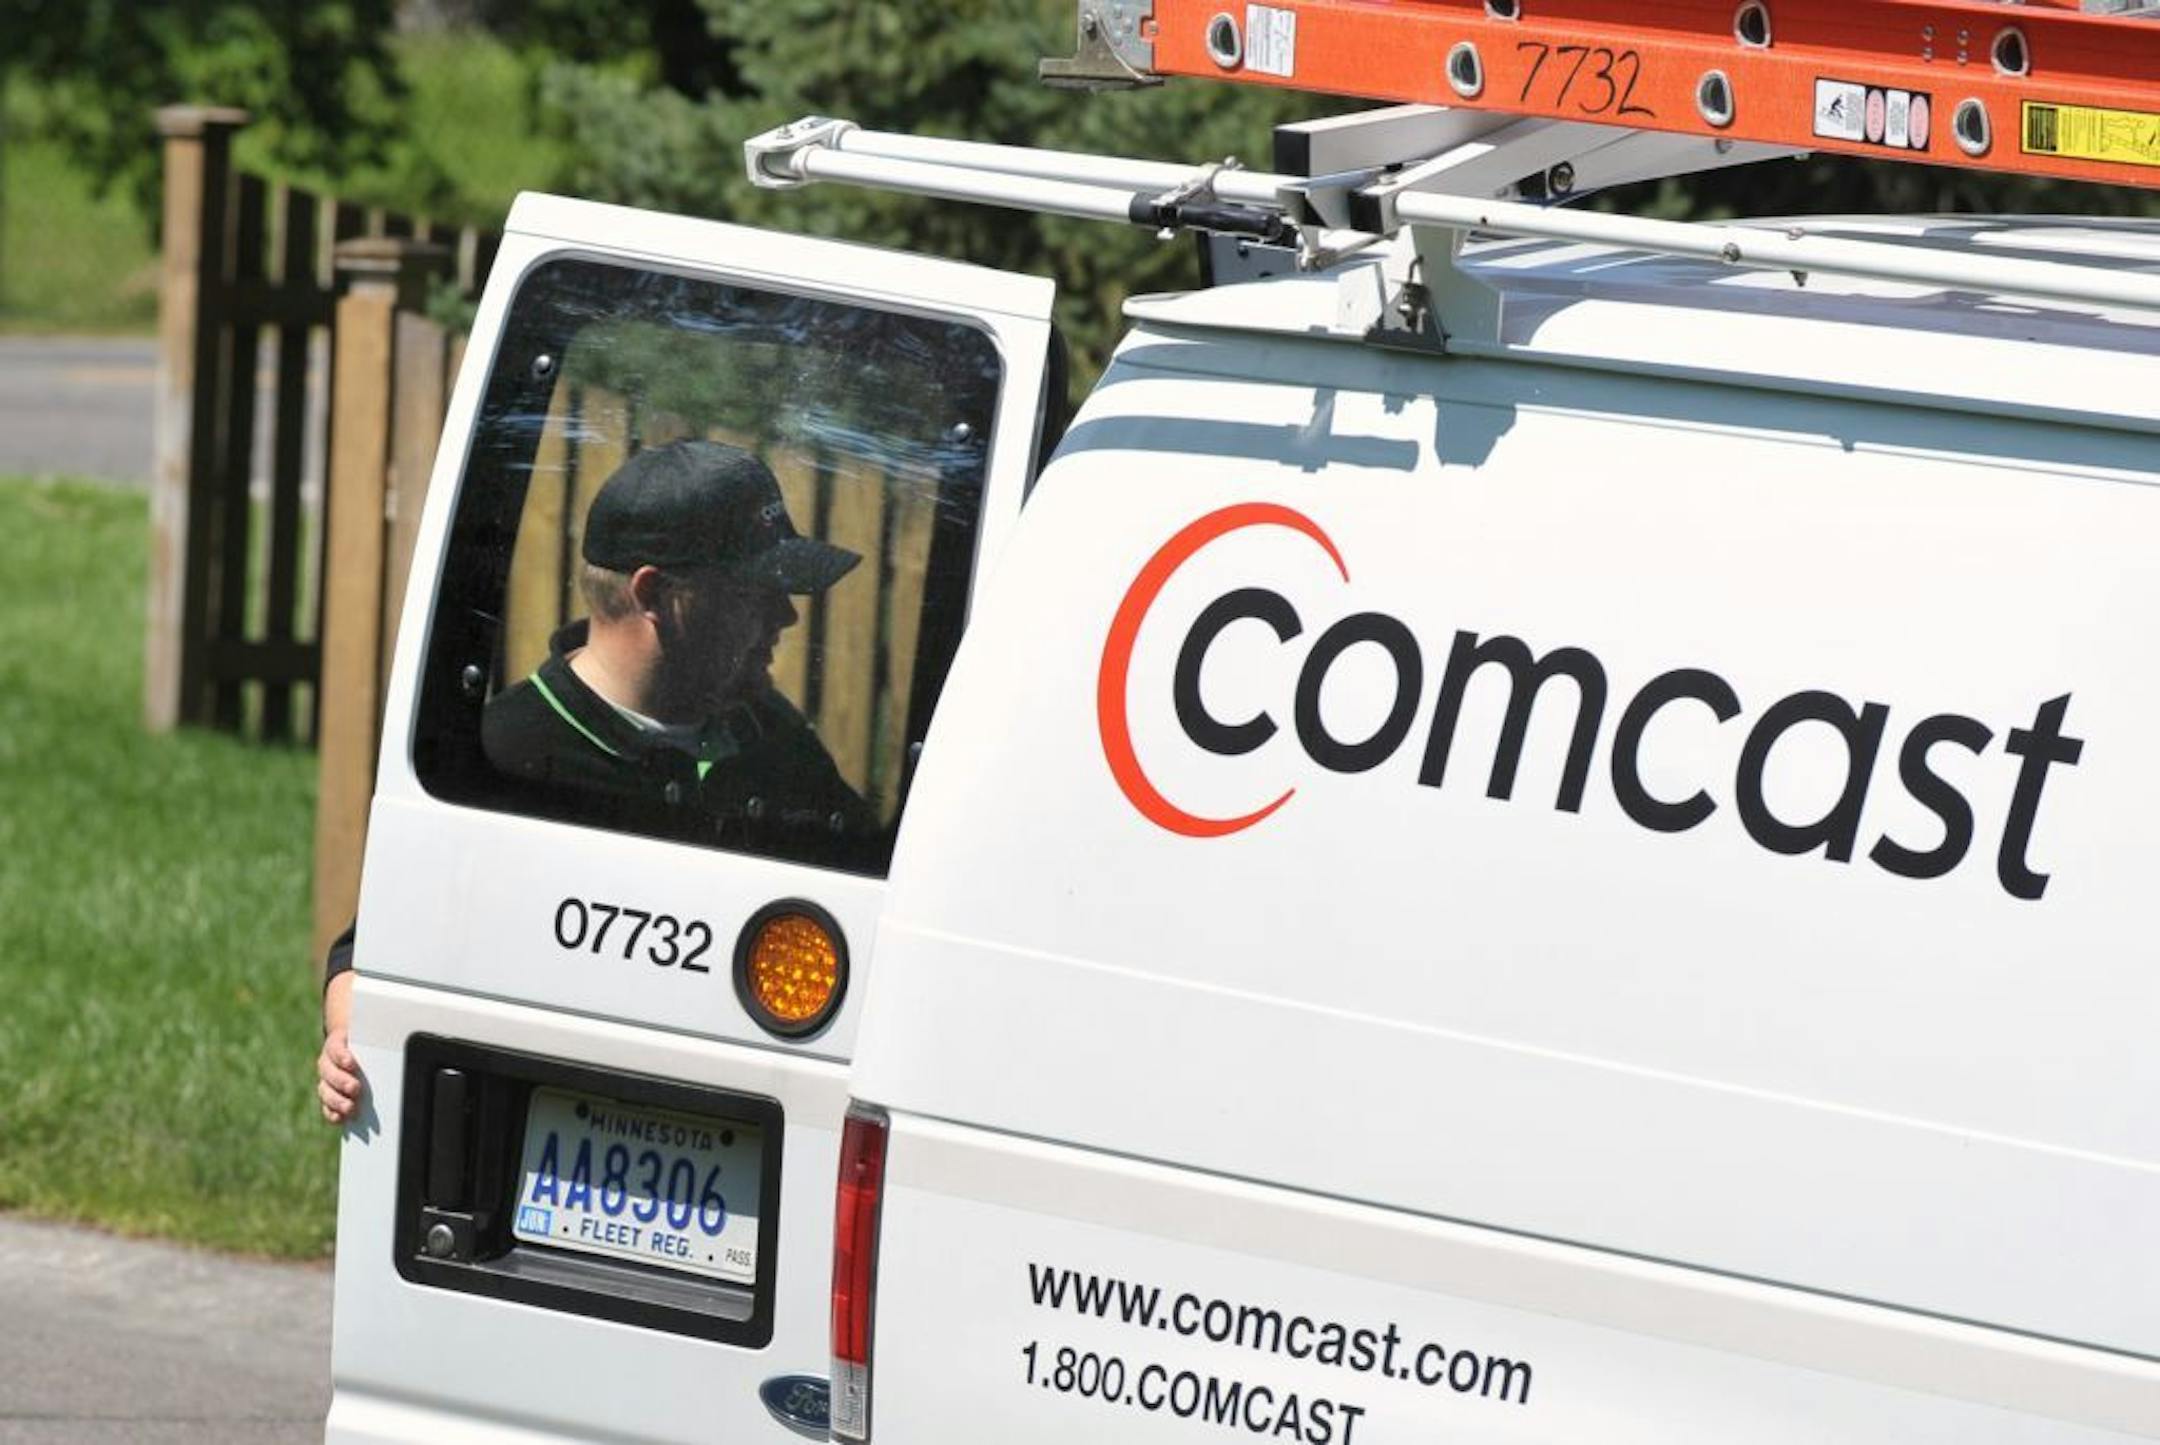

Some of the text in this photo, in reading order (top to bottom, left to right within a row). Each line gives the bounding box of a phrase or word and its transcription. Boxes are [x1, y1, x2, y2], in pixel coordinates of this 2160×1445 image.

[1516, 42, 1657, 118] 7732
[1172, 586, 2085, 902] comcast
[554, 897, 713, 974] 07732
[589, 1113, 714, 1151] MINNESOTA
[531, 1132, 726, 1236] AA8306
[580, 1218, 694, 1259] FLEET REG.
[1028, 1263, 1533, 1405] www.comcast.com
[1021, 1340, 1366, 1445] 1.800.COMCAST
